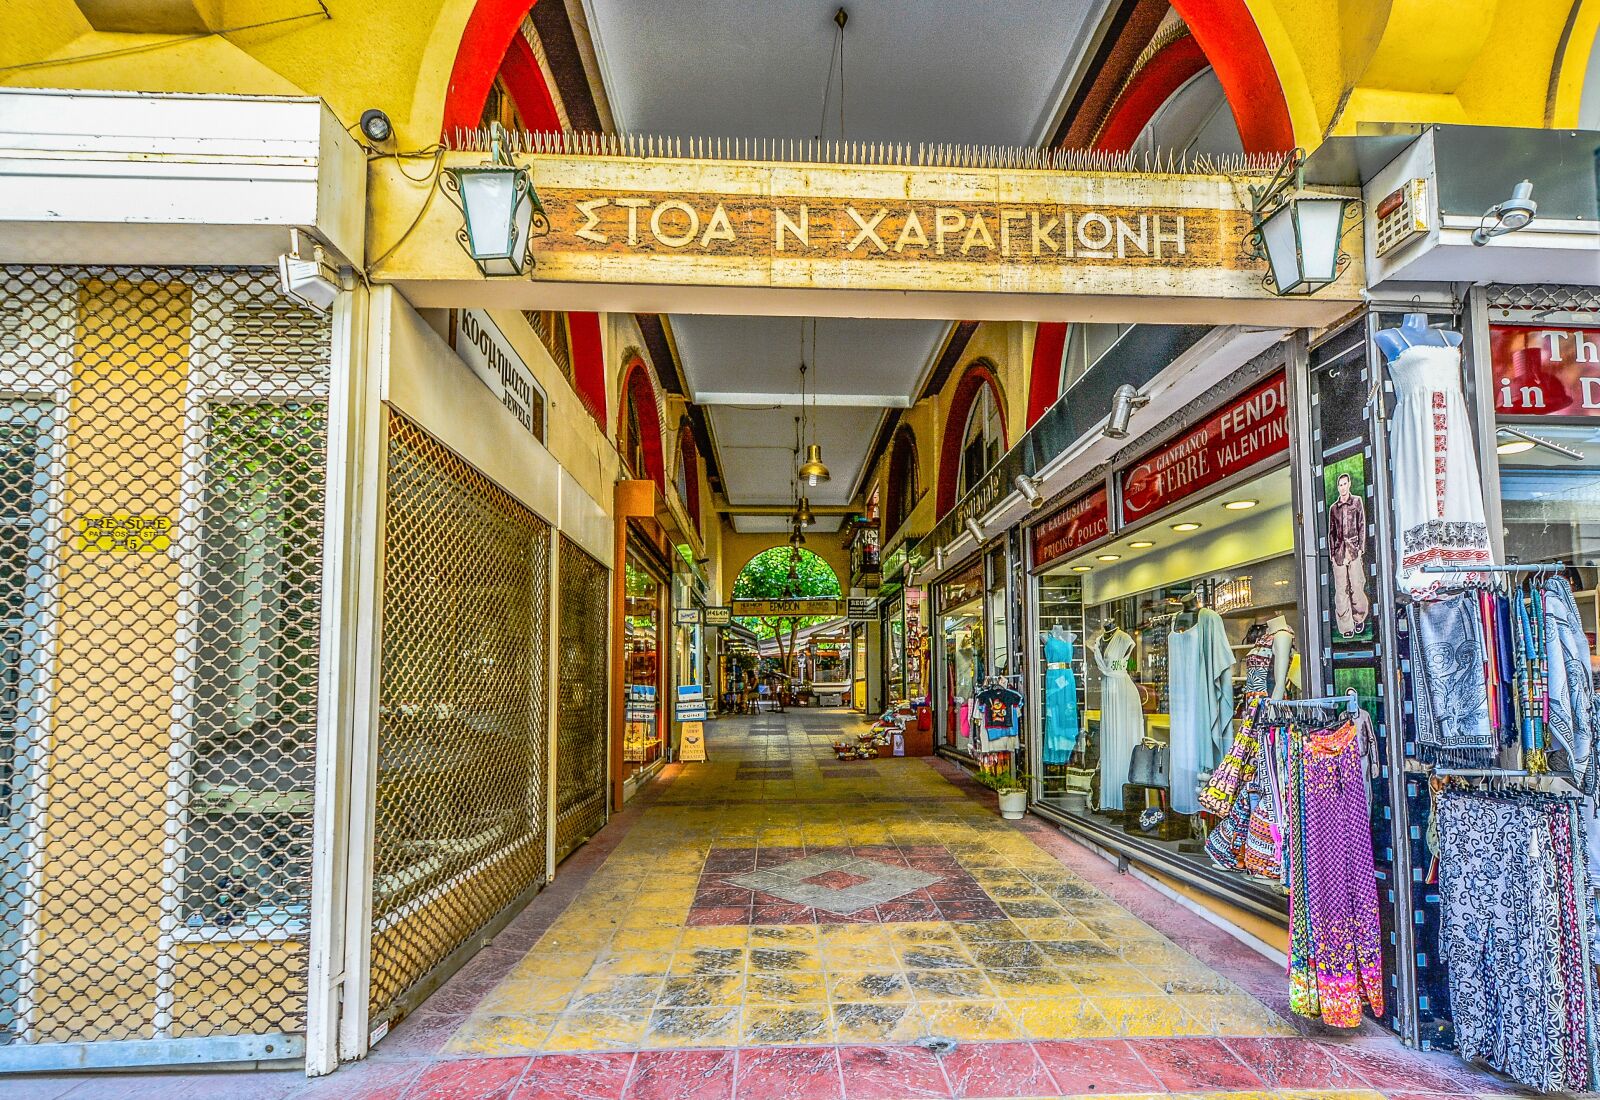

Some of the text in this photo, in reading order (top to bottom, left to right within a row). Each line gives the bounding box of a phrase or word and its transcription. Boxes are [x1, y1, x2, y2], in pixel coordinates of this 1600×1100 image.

[575, 197, 737, 249] ΣΤΟΑ
[844, 205, 1186, 260] ΧΑΡΑΓΚΙΩΝΗ
[502, 389, 531, 431] JEWELS
[1220, 381, 1286, 440] FENDI
[1500, 377, 1546, 408] in
[1156, 429, 1208, 472] GIANFRANCO
[1157, 447, 1210, 497] FERRE
[1048, 495, 1092, 532] EXCLUSIVE
[1043, 517, 1109, 559] PRICING POLICY
